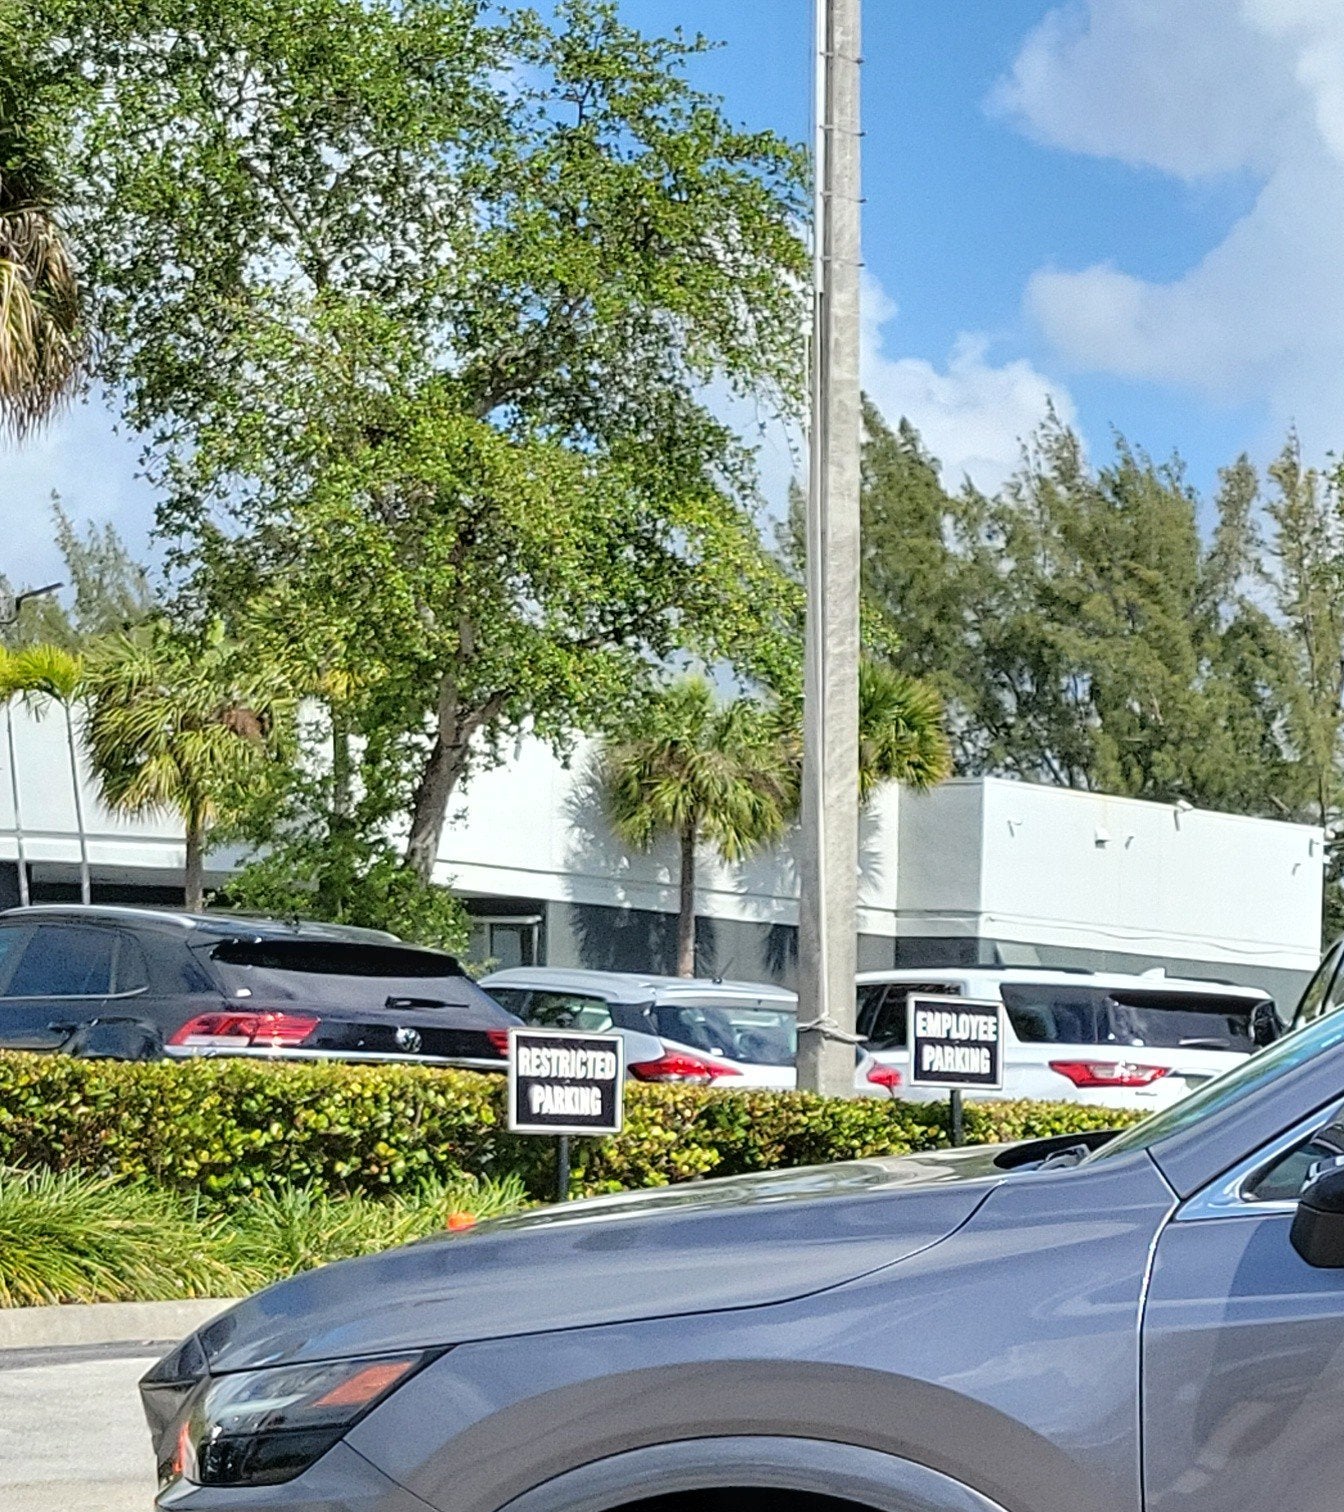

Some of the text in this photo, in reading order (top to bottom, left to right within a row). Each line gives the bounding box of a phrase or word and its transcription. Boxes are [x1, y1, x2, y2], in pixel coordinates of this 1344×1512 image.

[916, 1010, 997, 1042] EMPLOYEE
[518, 1047, 616, 1080] RESTRICTED
[922, 1044, 990, 1074] PARKING
[529, 1084, 602, 1116] PARKING
